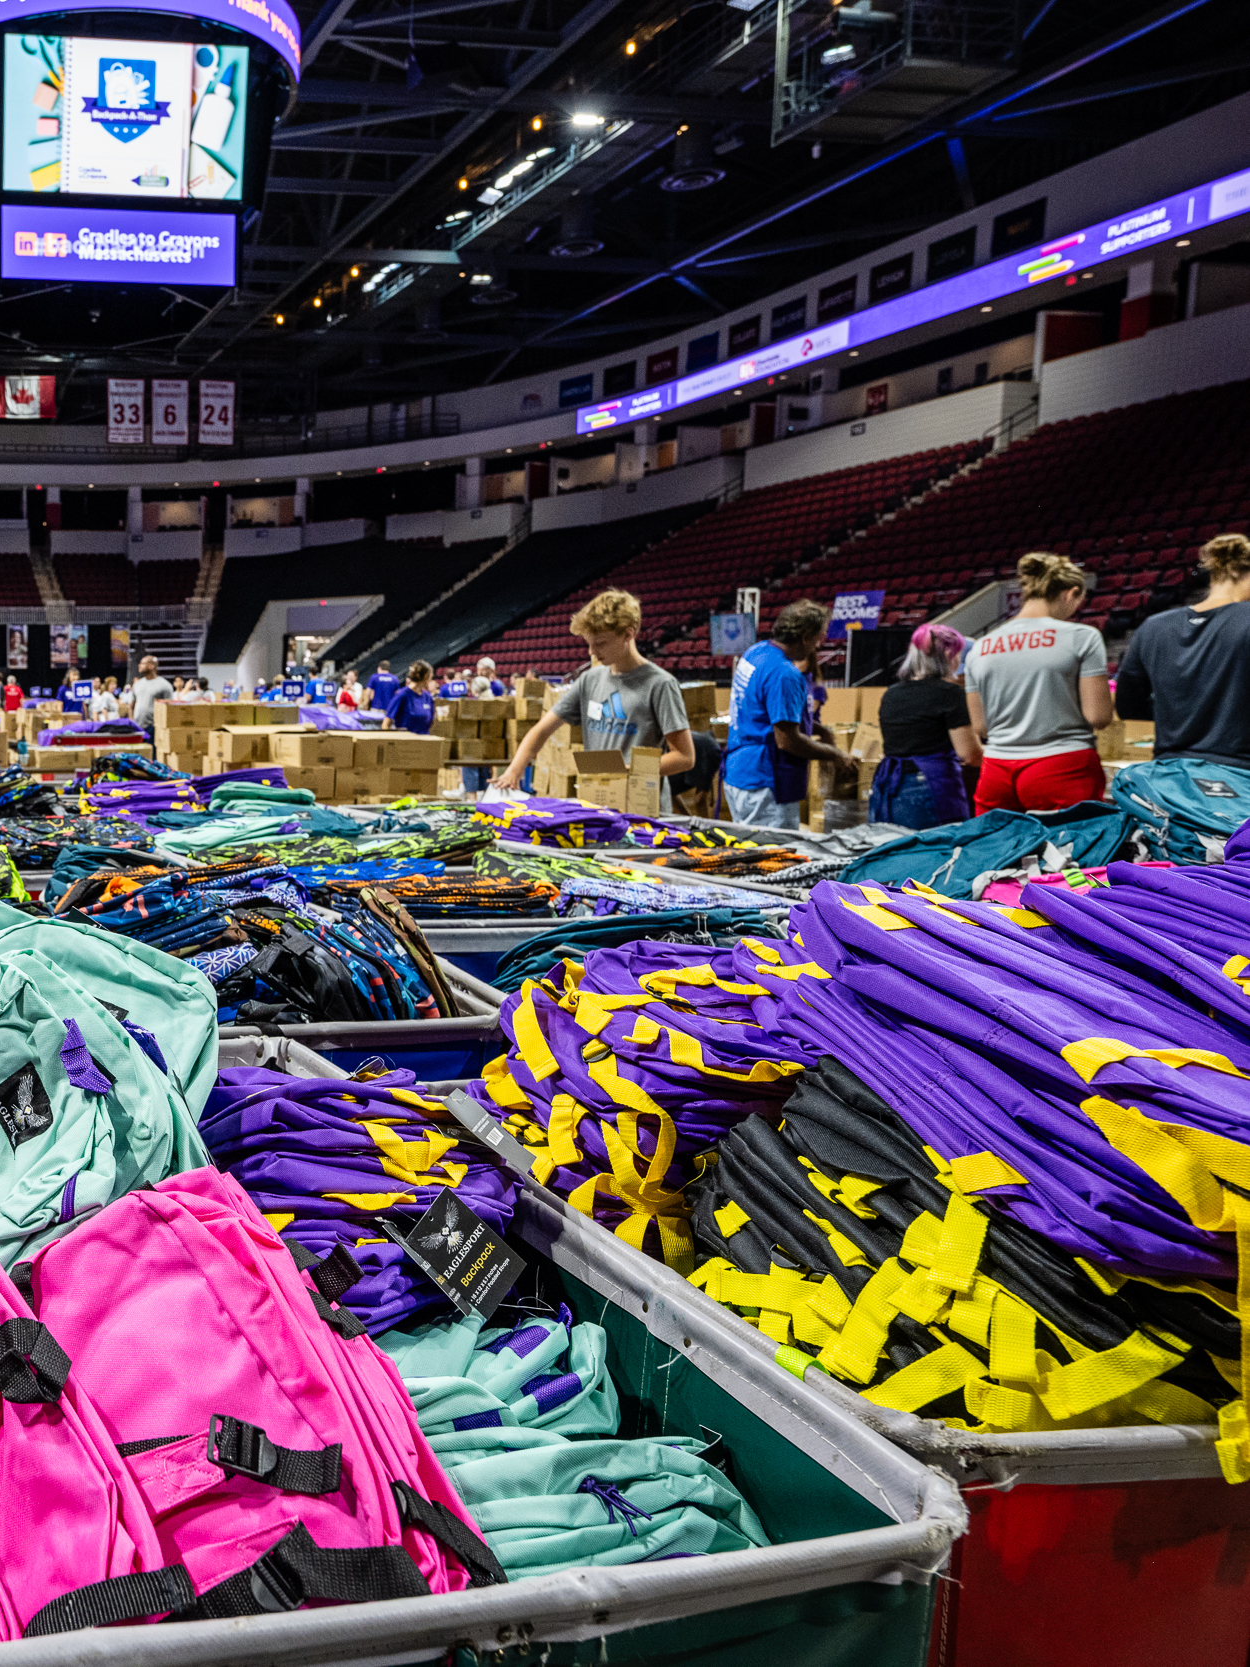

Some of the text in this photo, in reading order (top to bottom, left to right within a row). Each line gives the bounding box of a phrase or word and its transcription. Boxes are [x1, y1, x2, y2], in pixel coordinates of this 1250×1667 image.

[78, 228, 220, 249] Cradles to Crayons
[1100, 219, 1172, 255] SUPPORTERS
[79, 245, 192, 263] Massachusetts
[113, 403, 139, 424] 33
[164, 404, 176, 425] 6
[203, 404, 229, 426] 24
[832, 605, 880, 620] ROOMS
[980, 629, 1057, 657] DAWGS
[285, 686, 301, 696] 39
[443, 1223, 486, 1280] EAGLESPORT
[460, 1241, 496, 1288] Backpack
